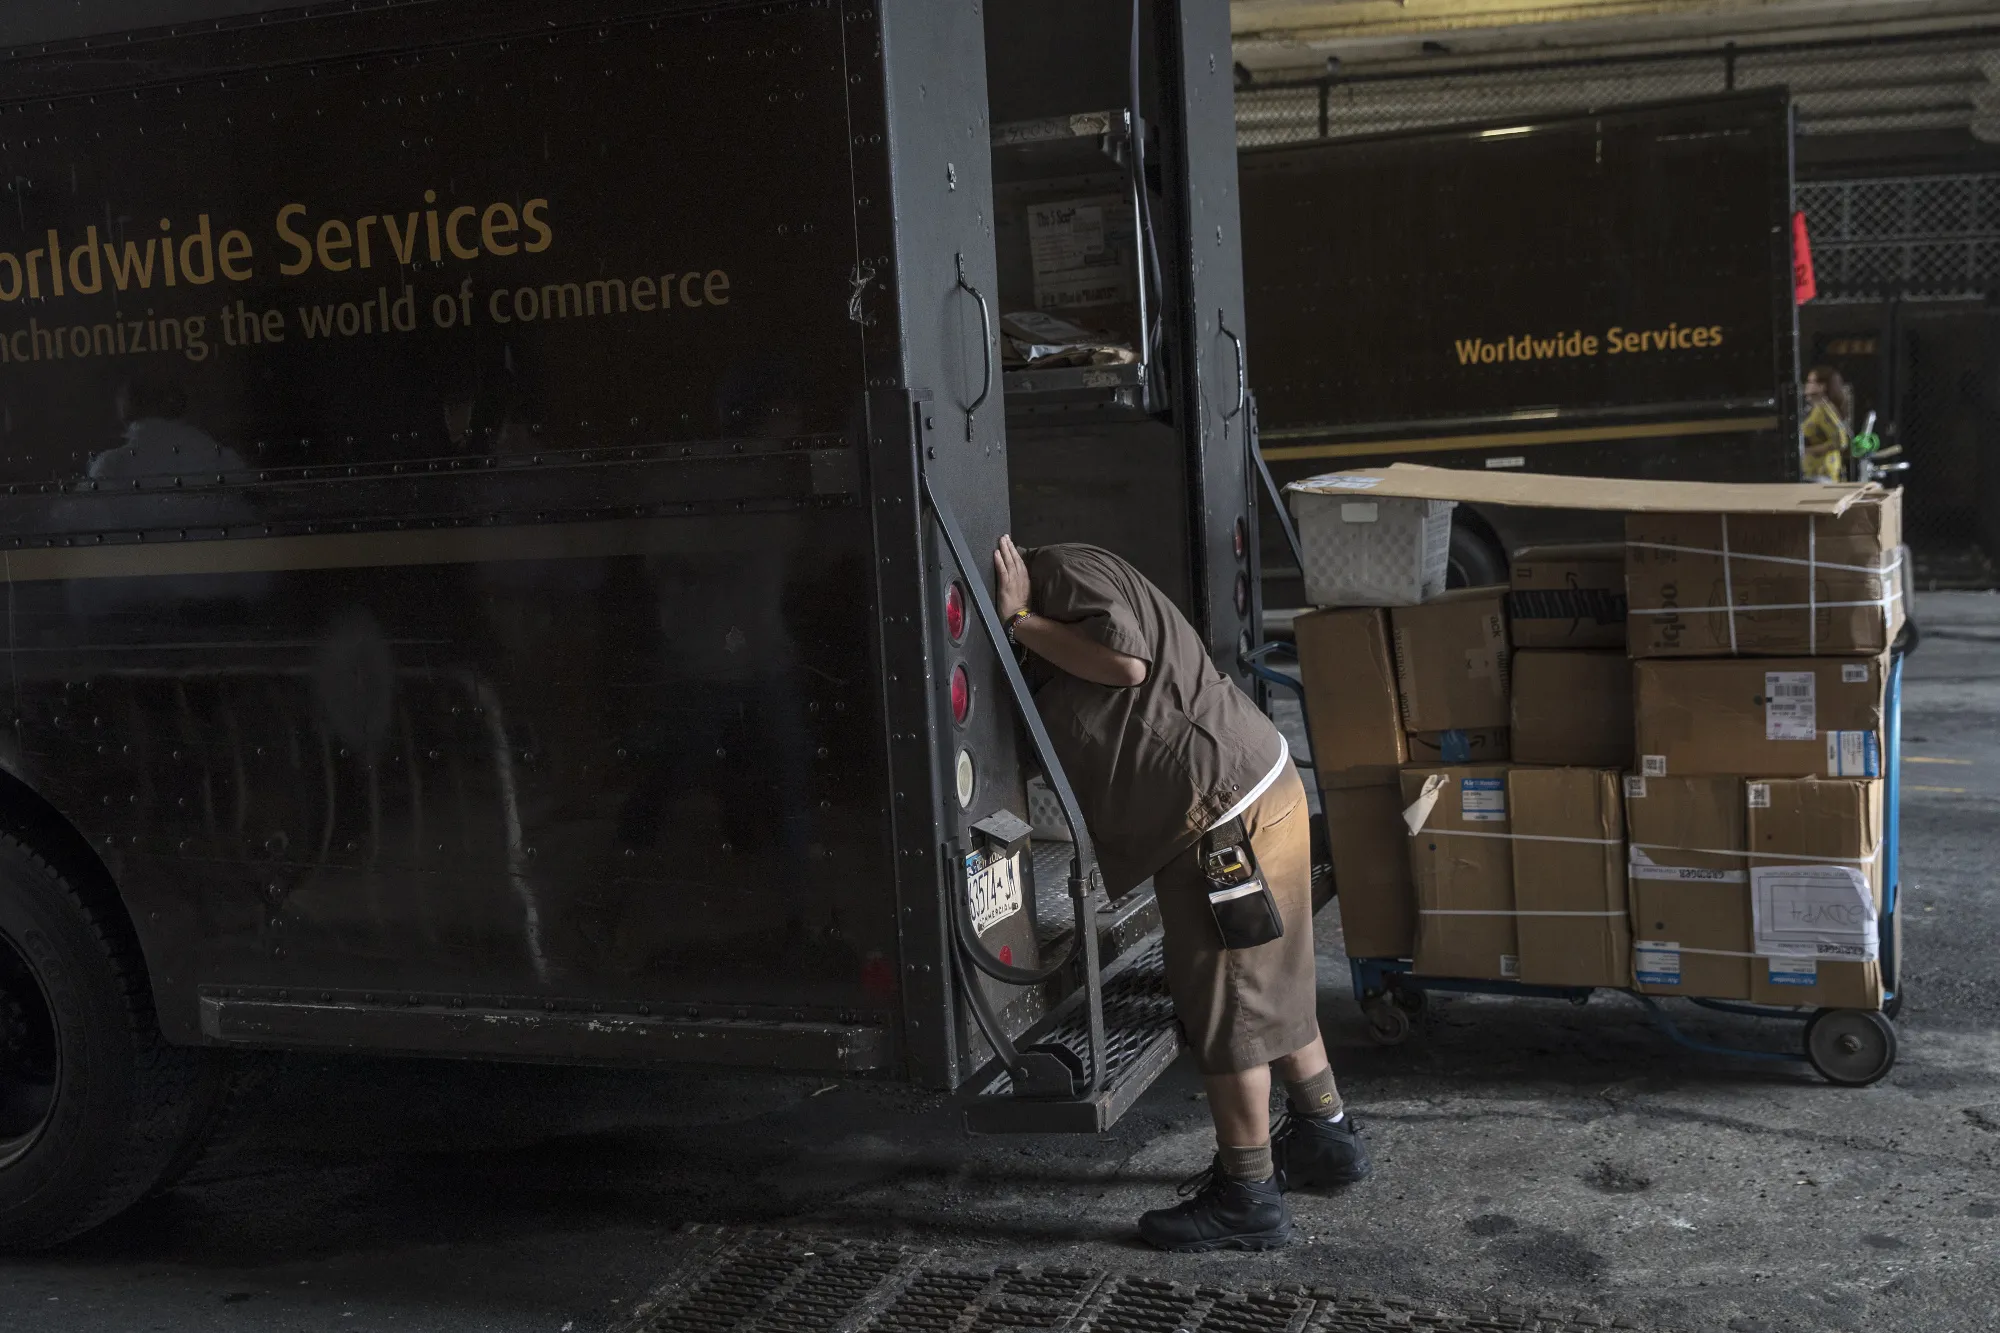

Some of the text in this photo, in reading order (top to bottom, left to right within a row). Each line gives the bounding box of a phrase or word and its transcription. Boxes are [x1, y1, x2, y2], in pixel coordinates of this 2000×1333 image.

[0, 189, 553, 302] orldwide Services
[220, 299, 285, 346] the
[299, 285, 416, 339] world
[432, 272, 475, 328] of
[489, 269, 731, 324] commerce
[1455, 322, 1722, 365] Worldwide Services
[1654, 584, 1686, 649] igloo
